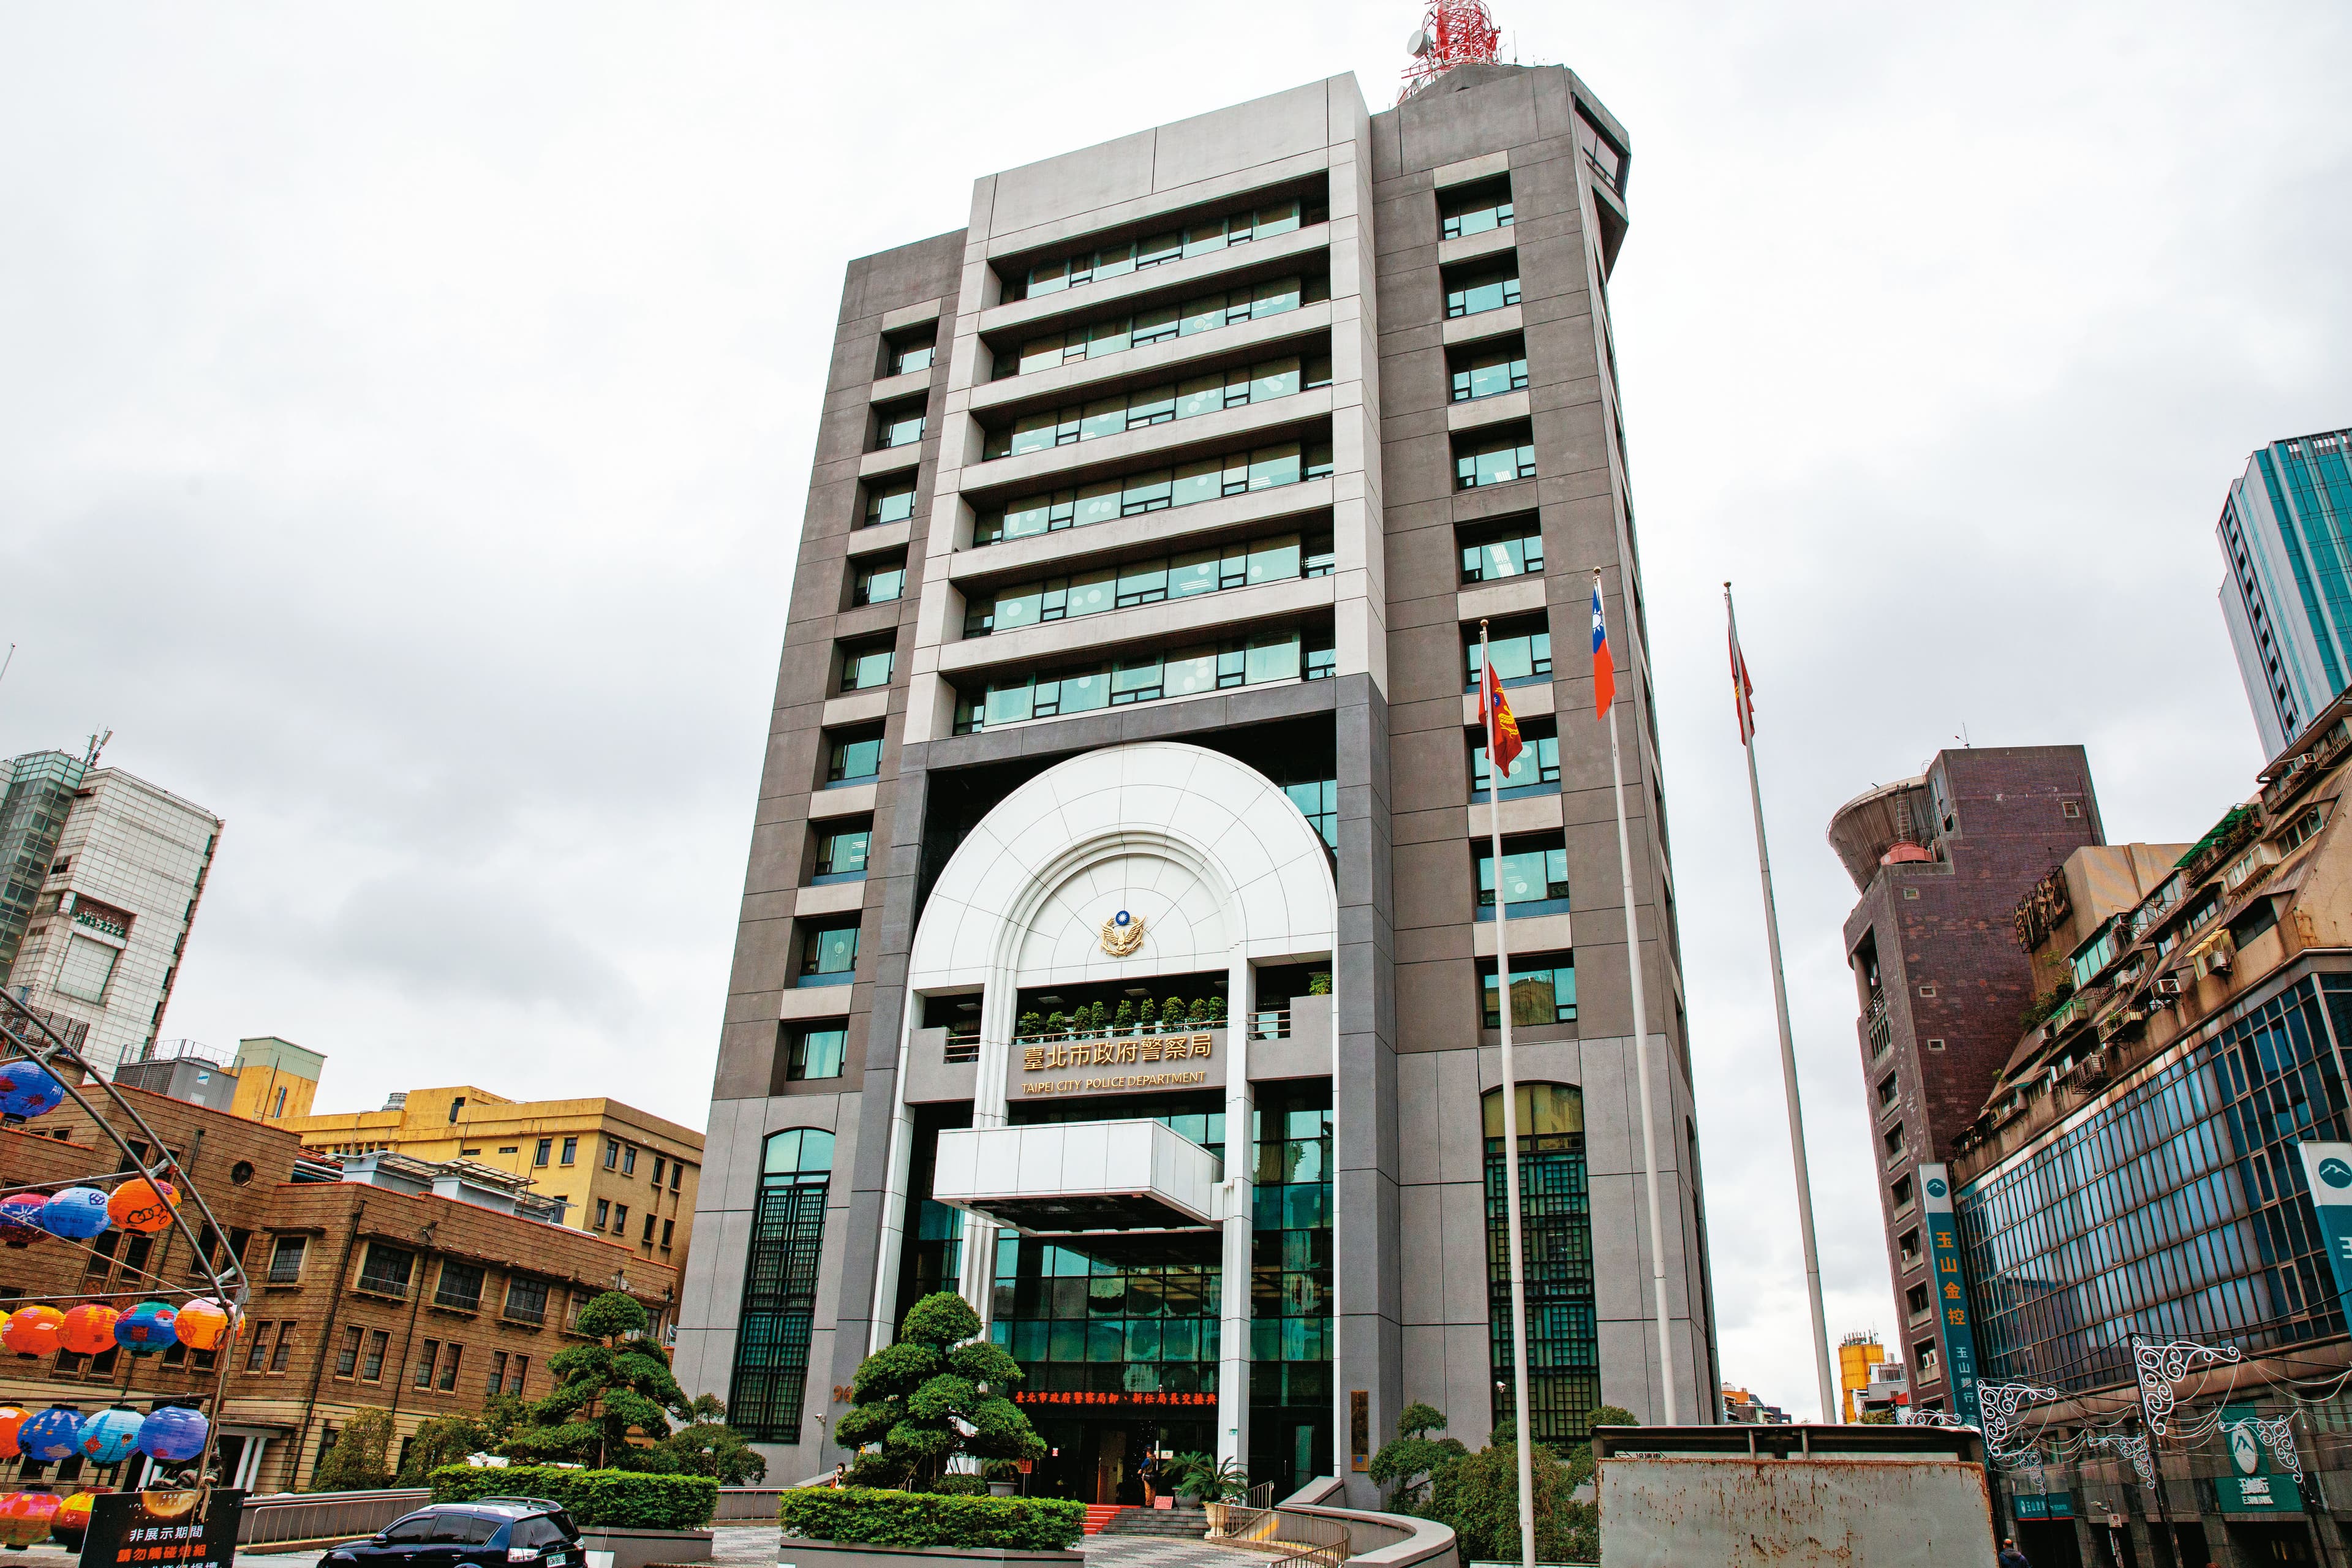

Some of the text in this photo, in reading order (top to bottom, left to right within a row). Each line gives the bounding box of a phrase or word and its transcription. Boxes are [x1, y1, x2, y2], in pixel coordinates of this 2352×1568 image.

[1023, 1033, 1212, 1071] 臺北市政府警察局
[1022, 1071, 1207, 1094] TAIPEI CITY POLICE DEPARTMENT
[1936, 1232, 1966, 1325] 玉山金控
[129, 1525, 204, 1542] 非展示期間
[116, 1544, 207, 1562] 請勿觸碰燈組
